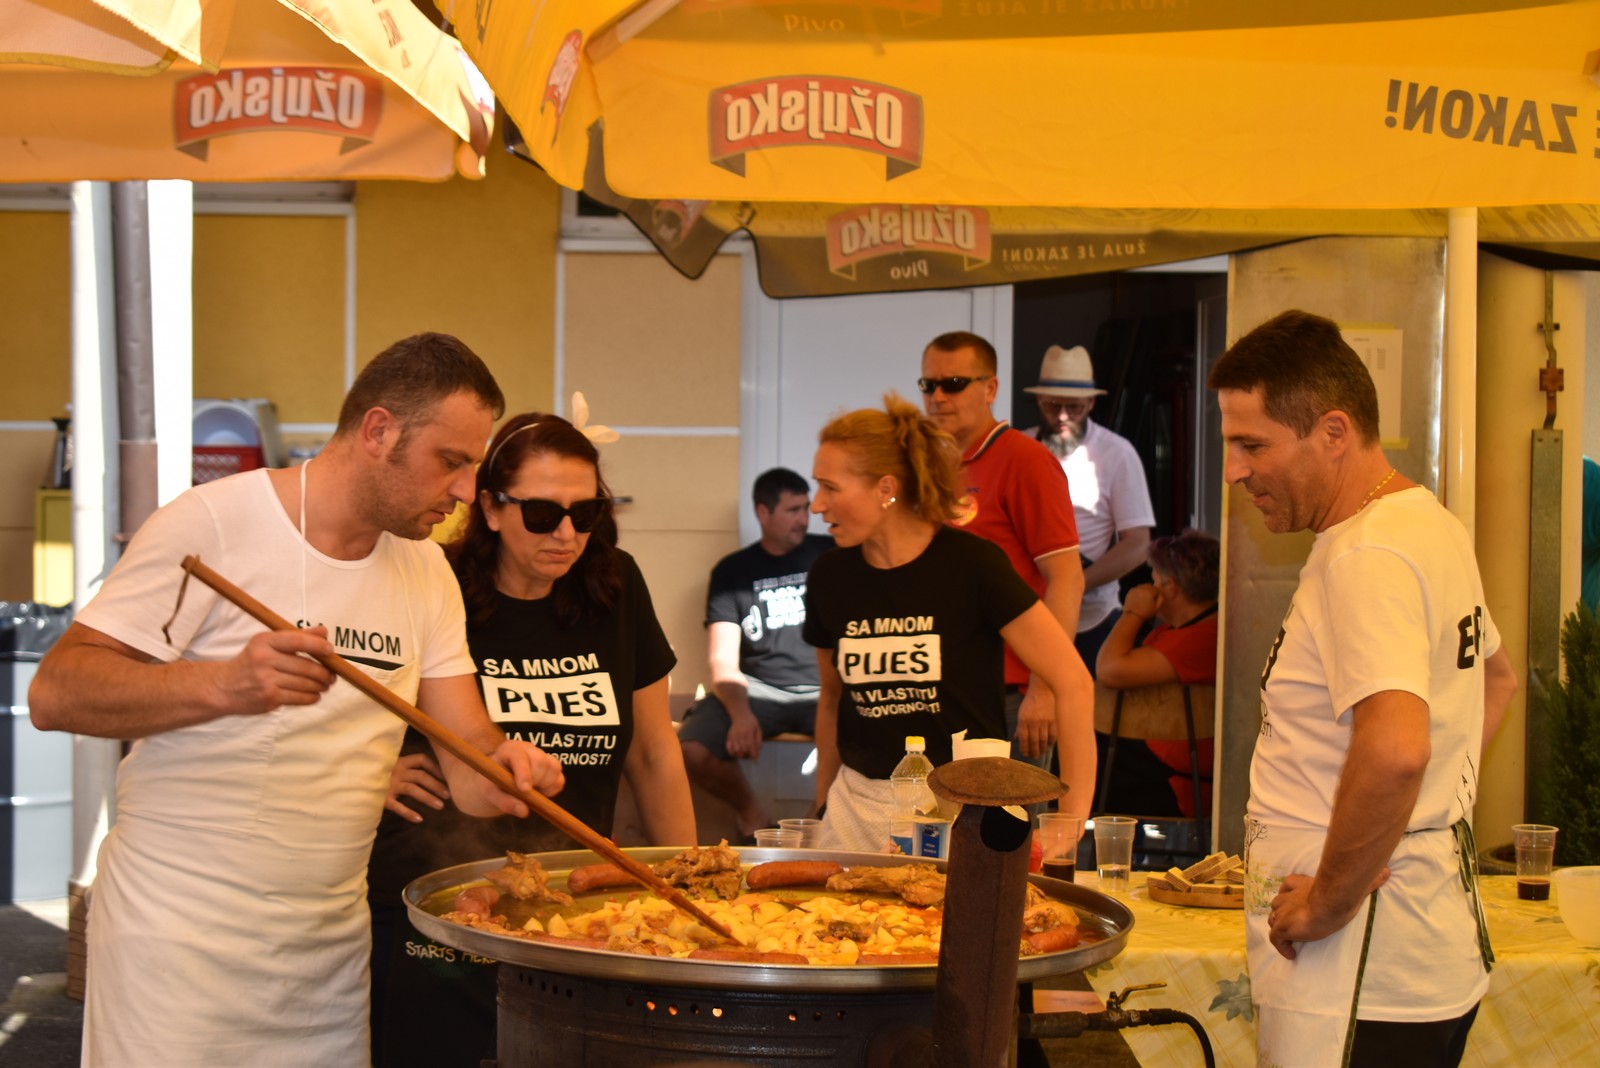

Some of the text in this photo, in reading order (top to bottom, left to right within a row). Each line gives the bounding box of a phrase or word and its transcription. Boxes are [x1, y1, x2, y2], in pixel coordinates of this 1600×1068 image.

[783, 13, 846, 33] Pivo
[846, 616, 934, 636] SA MNOM
[335, 626, 401, 656] MNOM
[483, 653, 600, 676] SA MNOM
[844, 643, 930, 676] PIJEŠ
[497, 681, 607, 717] PIJEŠ
[866, 686, 938, 703] VLASTITU
[528, 732, 617, 750] VLASTITU
[405, 941, 456, 963] STARTS
